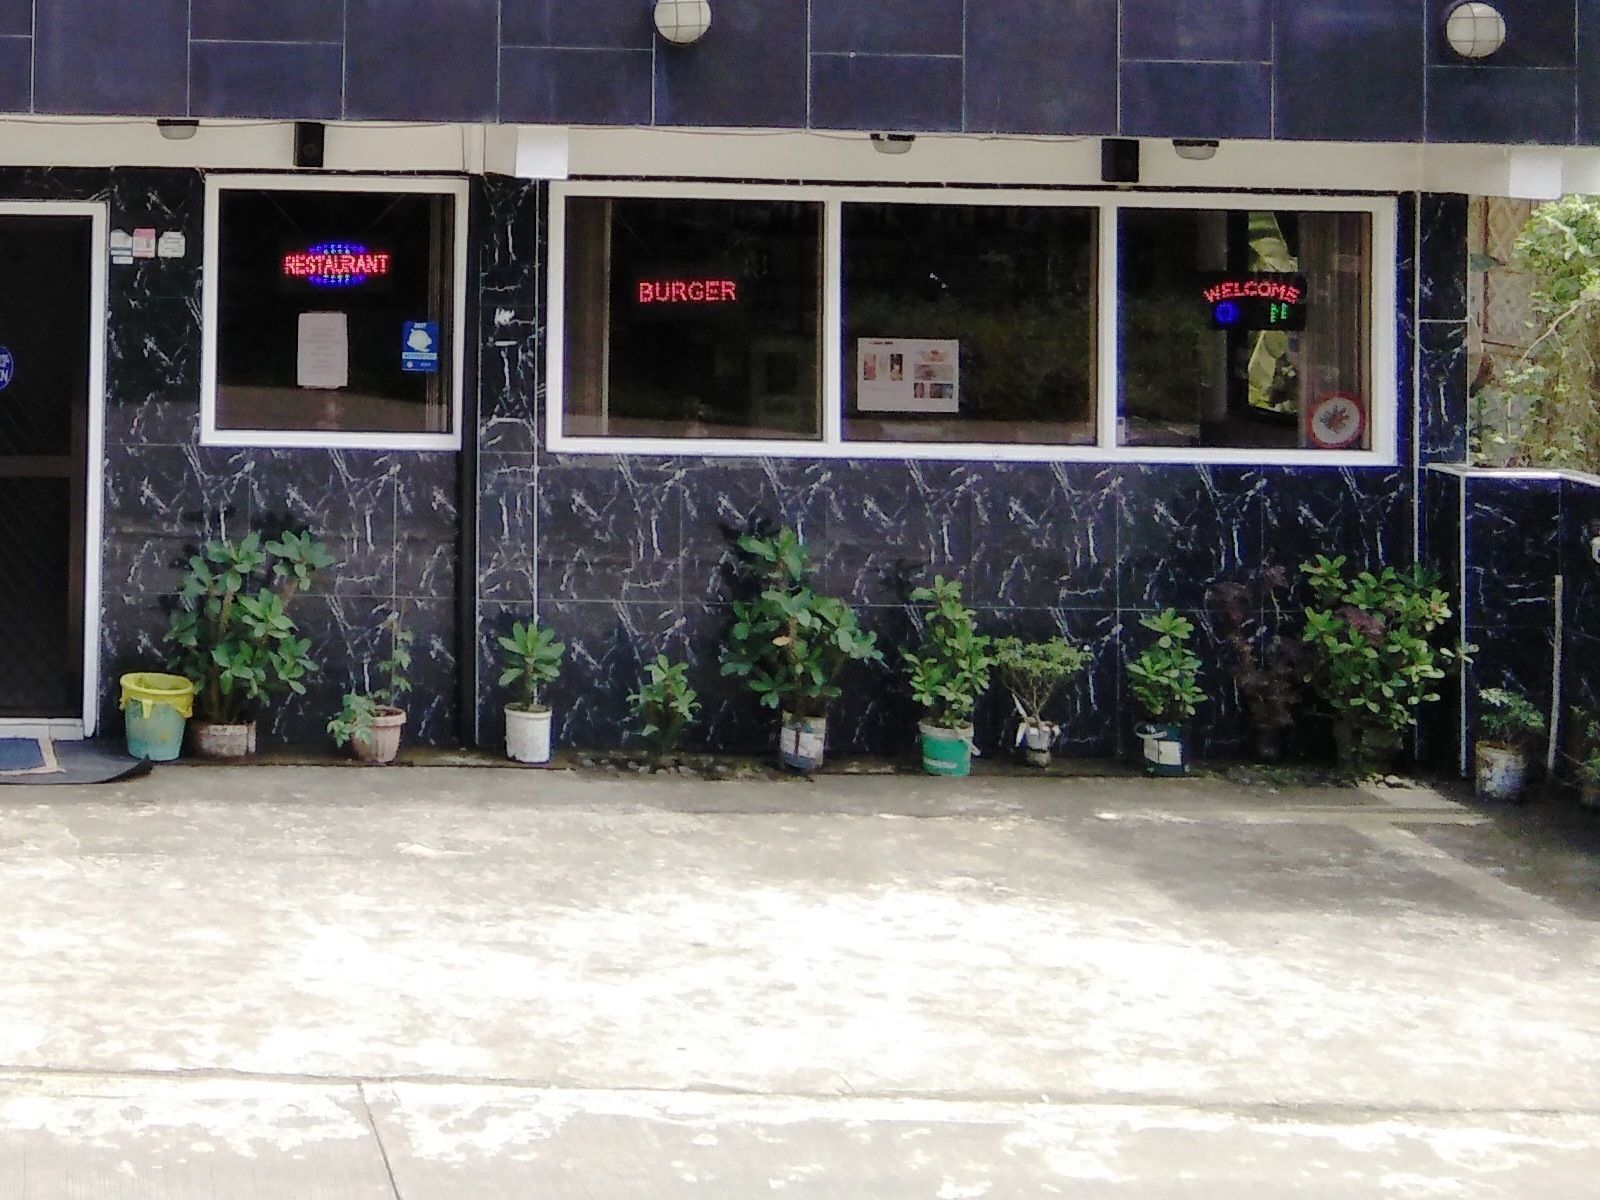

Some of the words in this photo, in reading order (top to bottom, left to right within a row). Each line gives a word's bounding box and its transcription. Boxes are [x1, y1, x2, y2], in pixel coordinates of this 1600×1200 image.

[283, 254, 389, 275] RESTAURANT
[638, 280, 737, 303] BURGER
[1203, 281, 1301, 304] WELCOME
